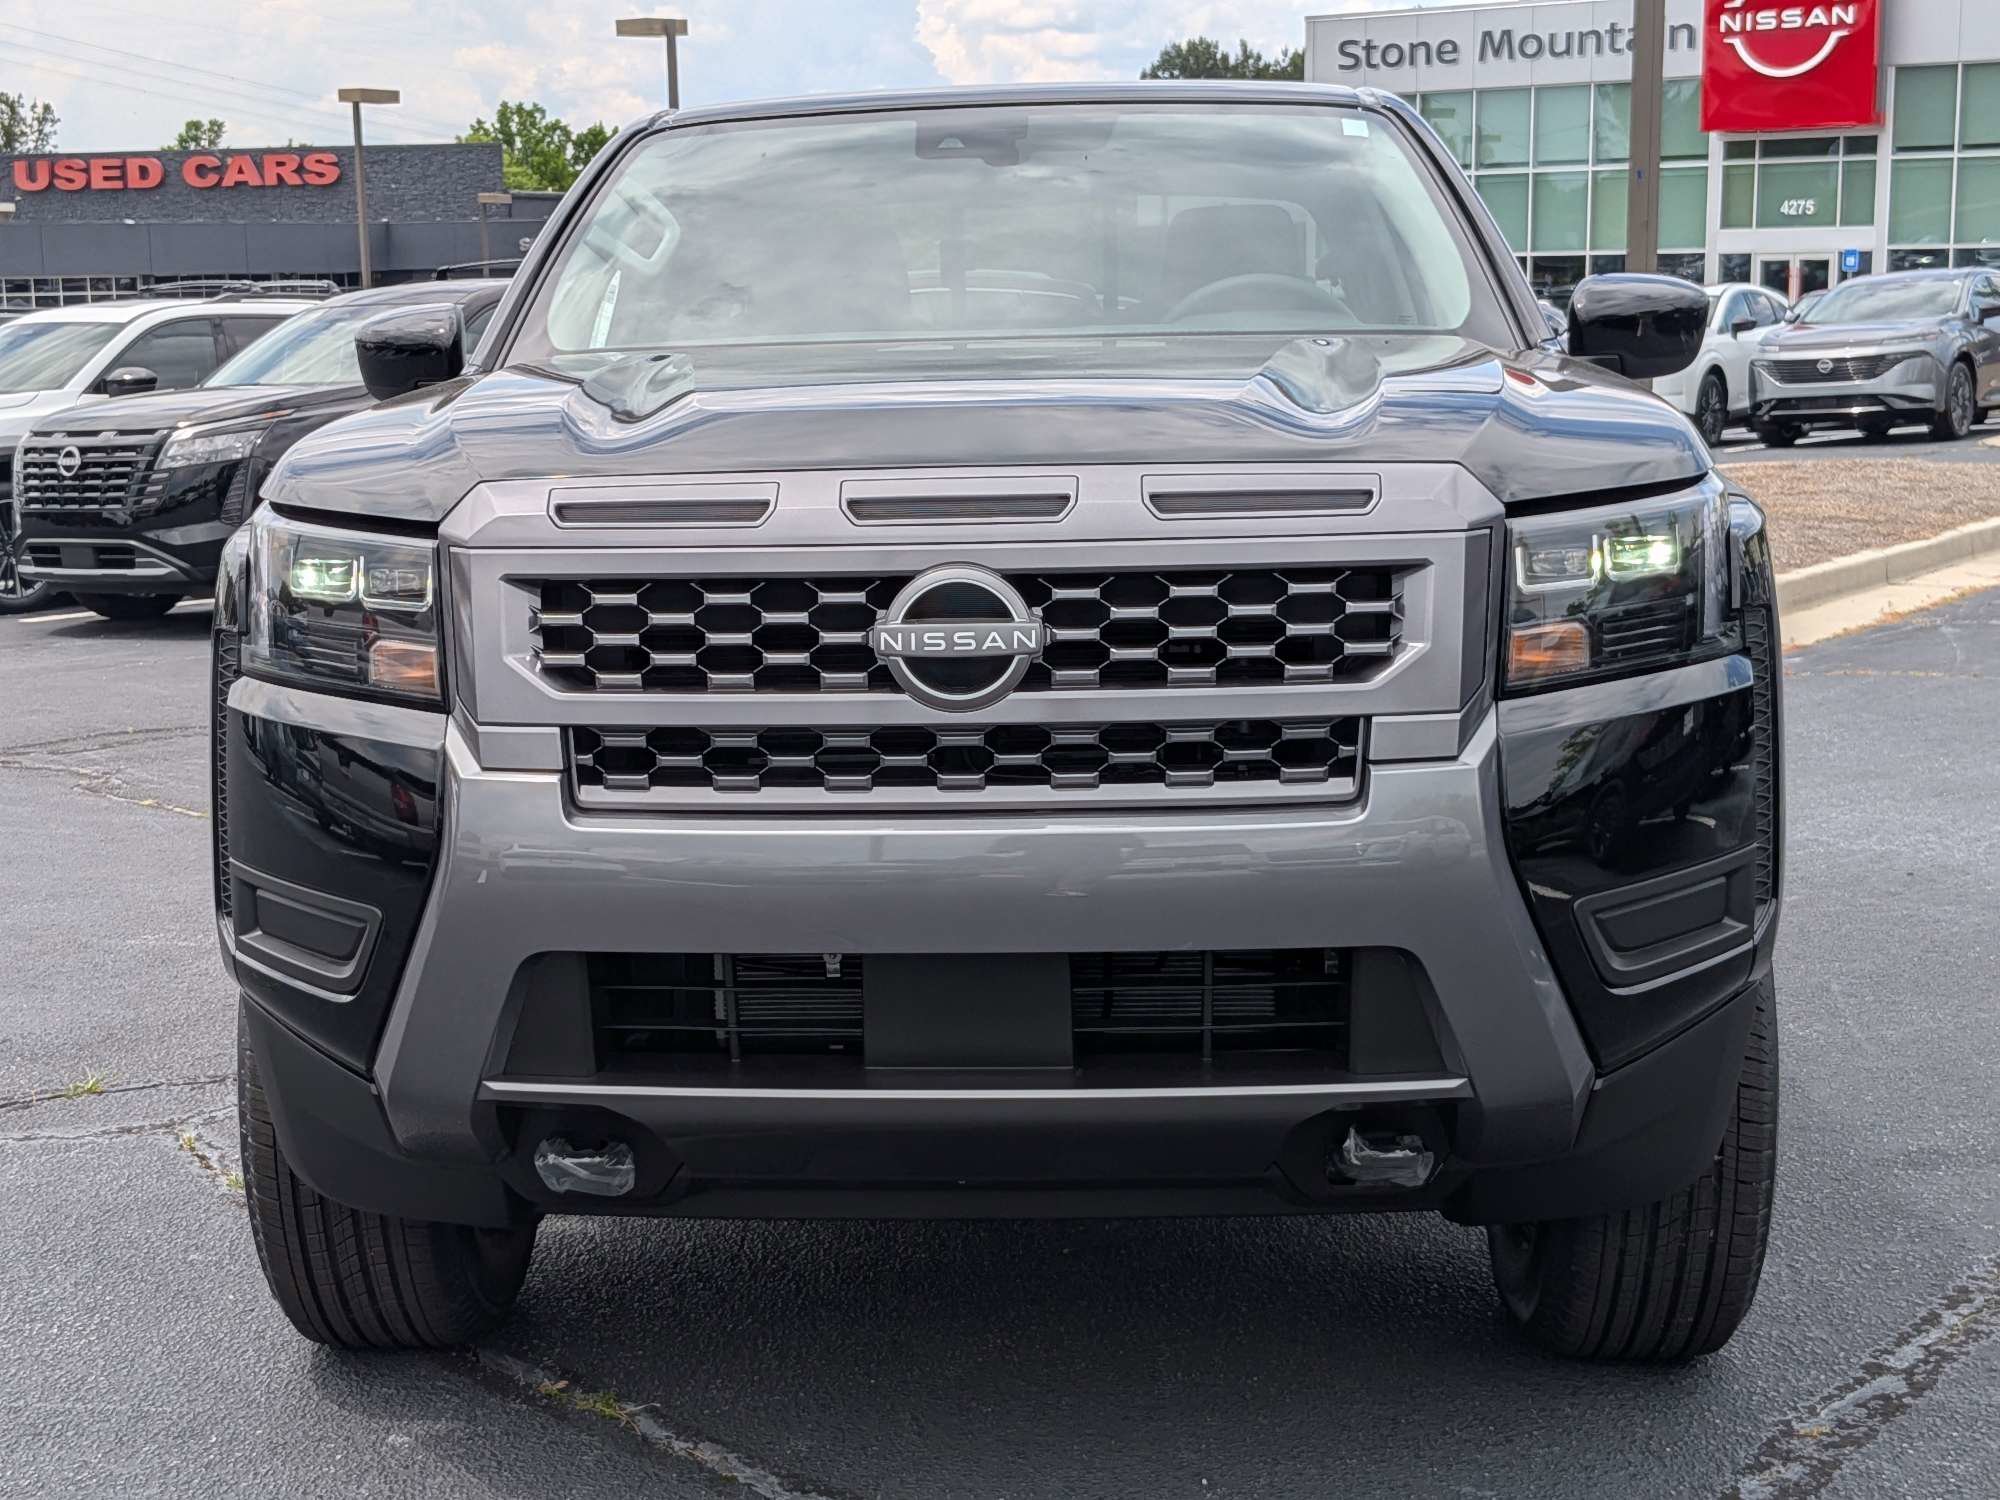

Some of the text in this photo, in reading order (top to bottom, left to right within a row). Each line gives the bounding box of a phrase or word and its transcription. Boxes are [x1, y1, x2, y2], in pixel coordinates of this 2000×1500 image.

[1719, 5, 1855, 33] NISSAN
[1337, 21, 1696, 72] Stone Mountn
[13, 152, 342, 192] USED CARS
[1779, 199, 1816, 216] 4275
[879, 629, 1037, 652] NISSAN
